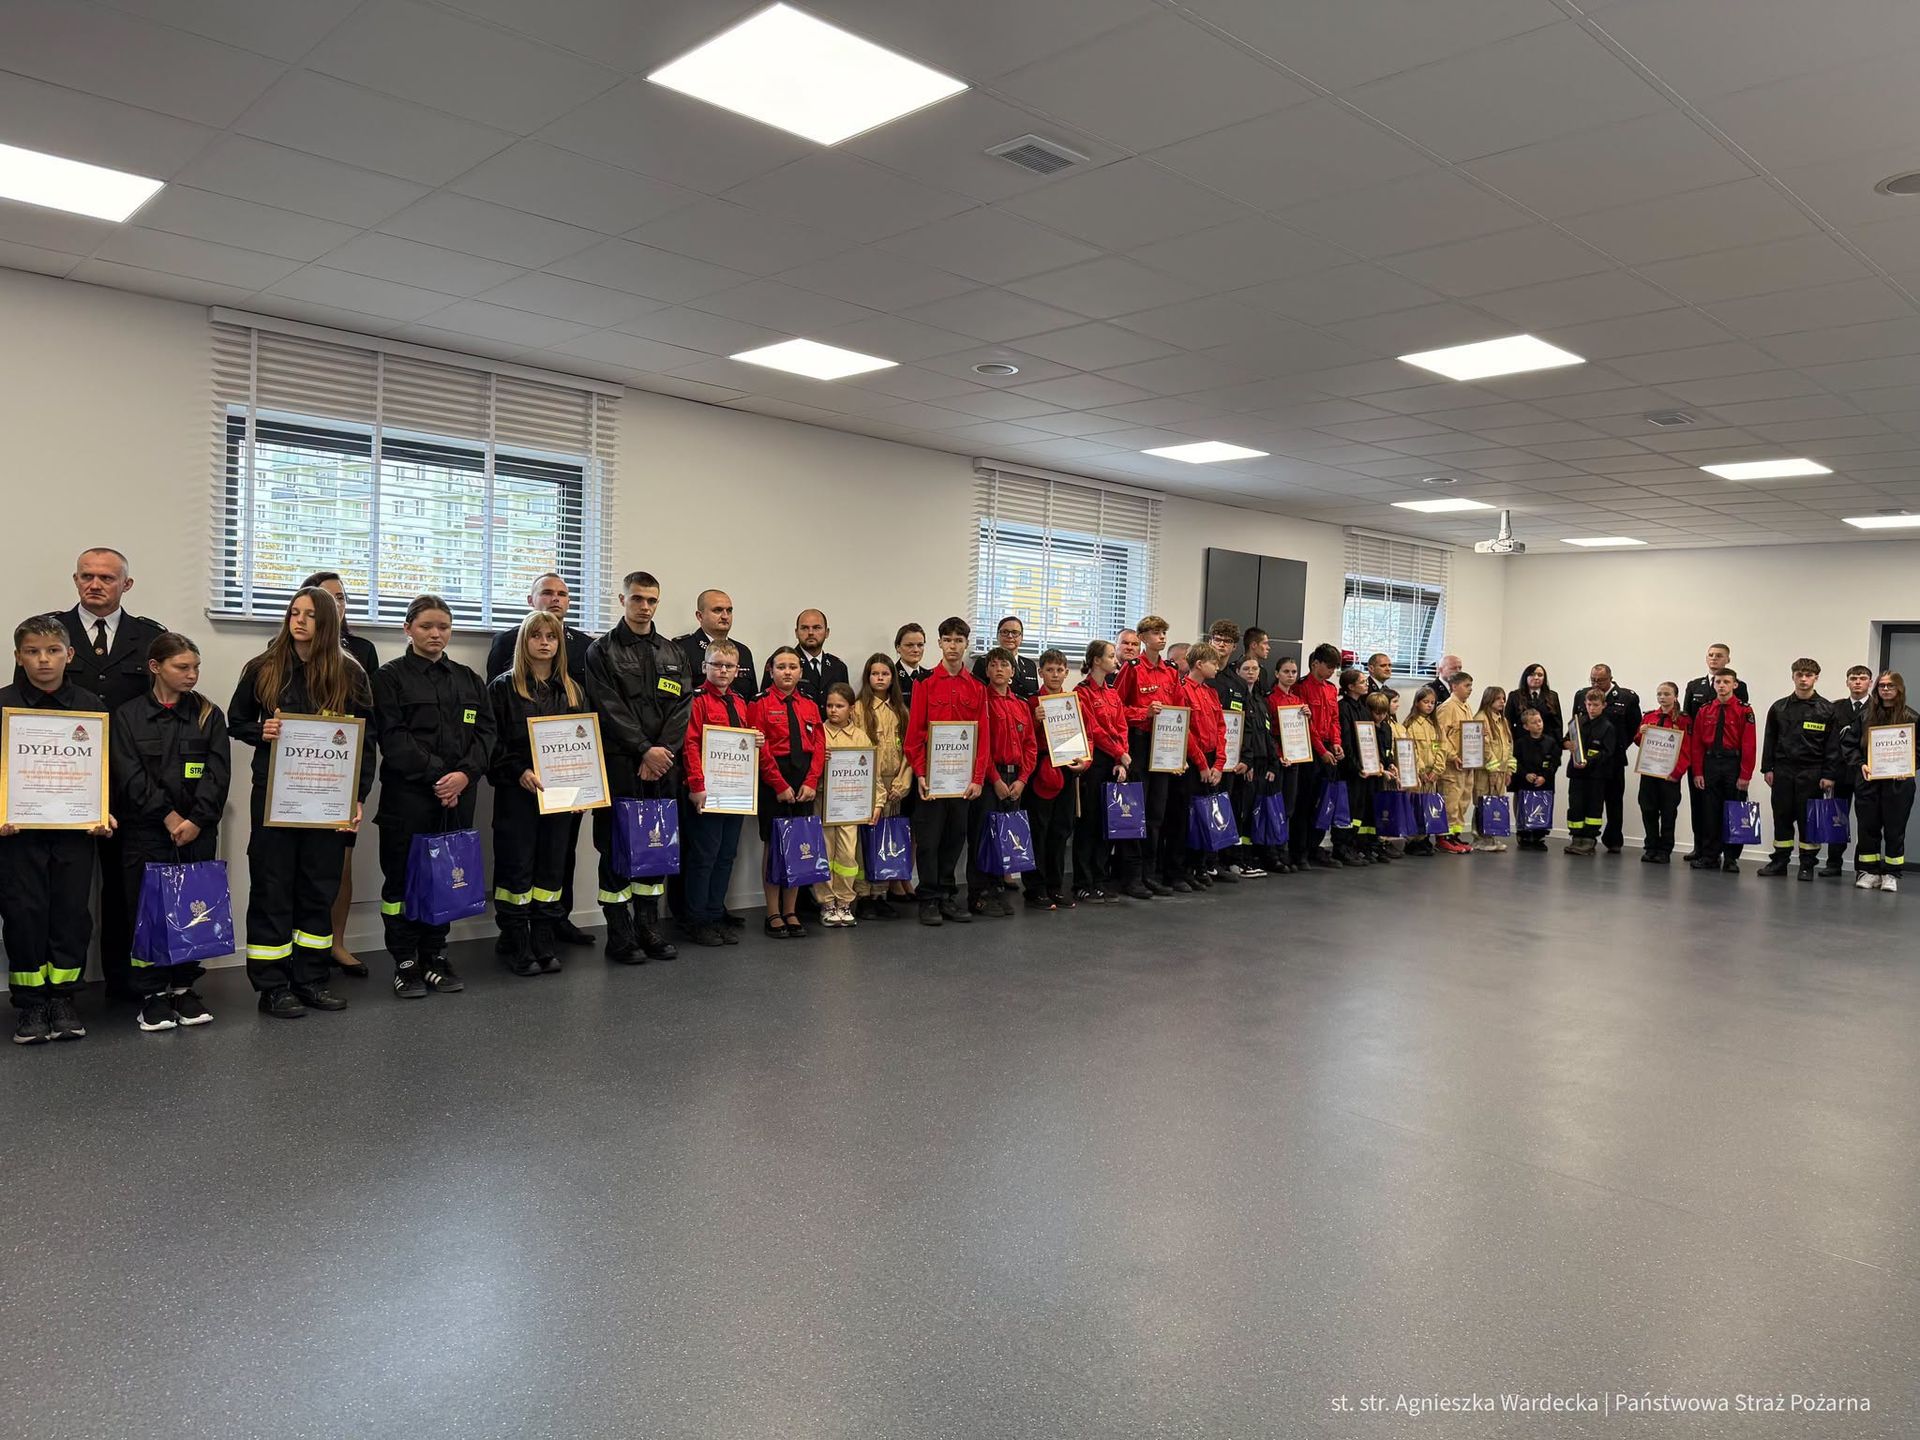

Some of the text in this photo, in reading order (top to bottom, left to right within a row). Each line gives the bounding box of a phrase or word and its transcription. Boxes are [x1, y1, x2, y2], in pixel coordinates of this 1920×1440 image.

[1048, 712, 1077, 724] DYPLOM
[541, 742, 592, 754] DYPLOM
[935, 743, 970, 752] DYPLOM
[1647, 738, 1675, 749] DYPLOM
[1875, 740, 1908, 748] DYPLOM
[17, 744, 92, 757] DYPLOM
[285, 746, 349, 760] DYPLOM
[710, 751, 750, 763] DYPLOM
[831, 768, 869, 778] DYPLOM
